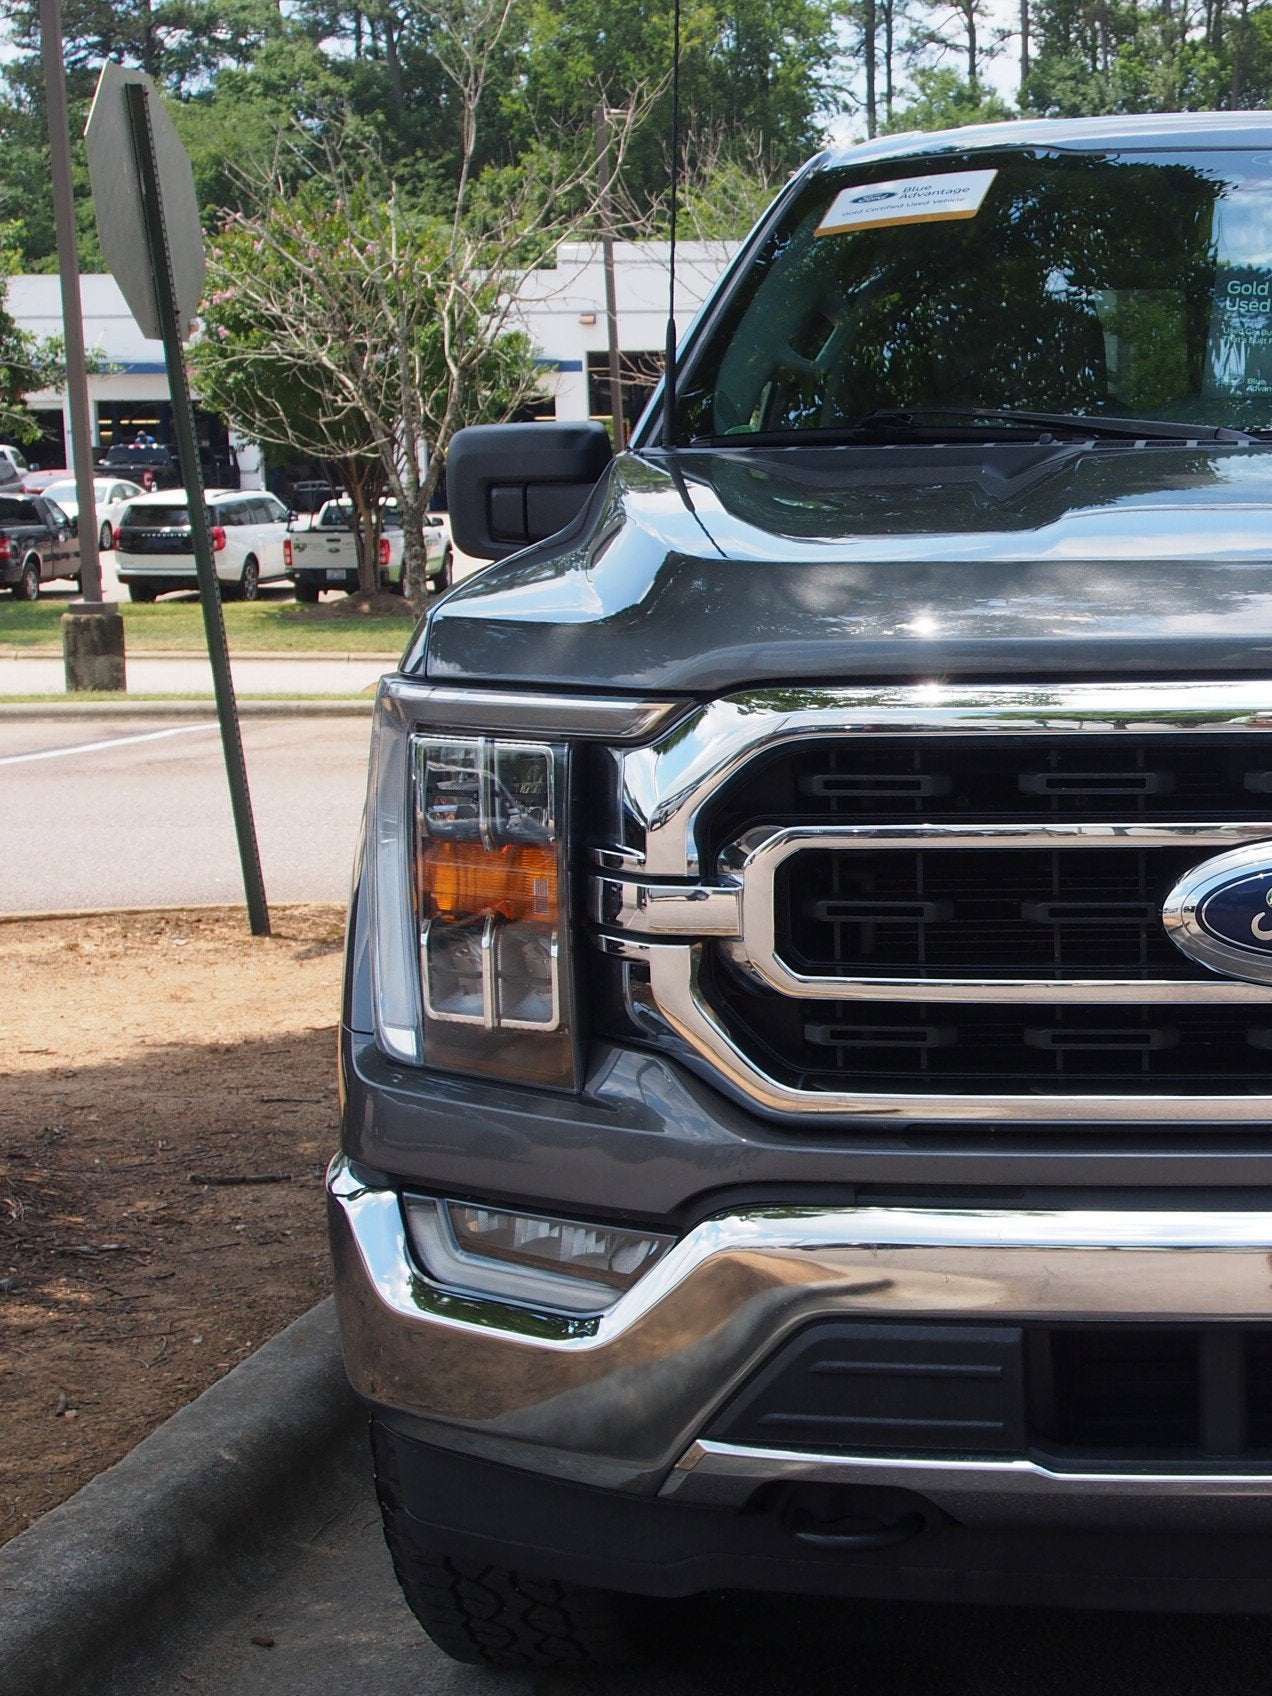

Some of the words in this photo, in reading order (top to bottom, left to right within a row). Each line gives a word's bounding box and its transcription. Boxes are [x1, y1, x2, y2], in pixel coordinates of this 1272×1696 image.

[899, 187, 970, 199] Advantage
[902, 185, 932, 193] Blue
[865, 203, 904, 213] Certified
[906, 200, 930, 208] Used
[1226, 280, 1269, 296] Gold
[1225, 297, 1271, 313] Used
